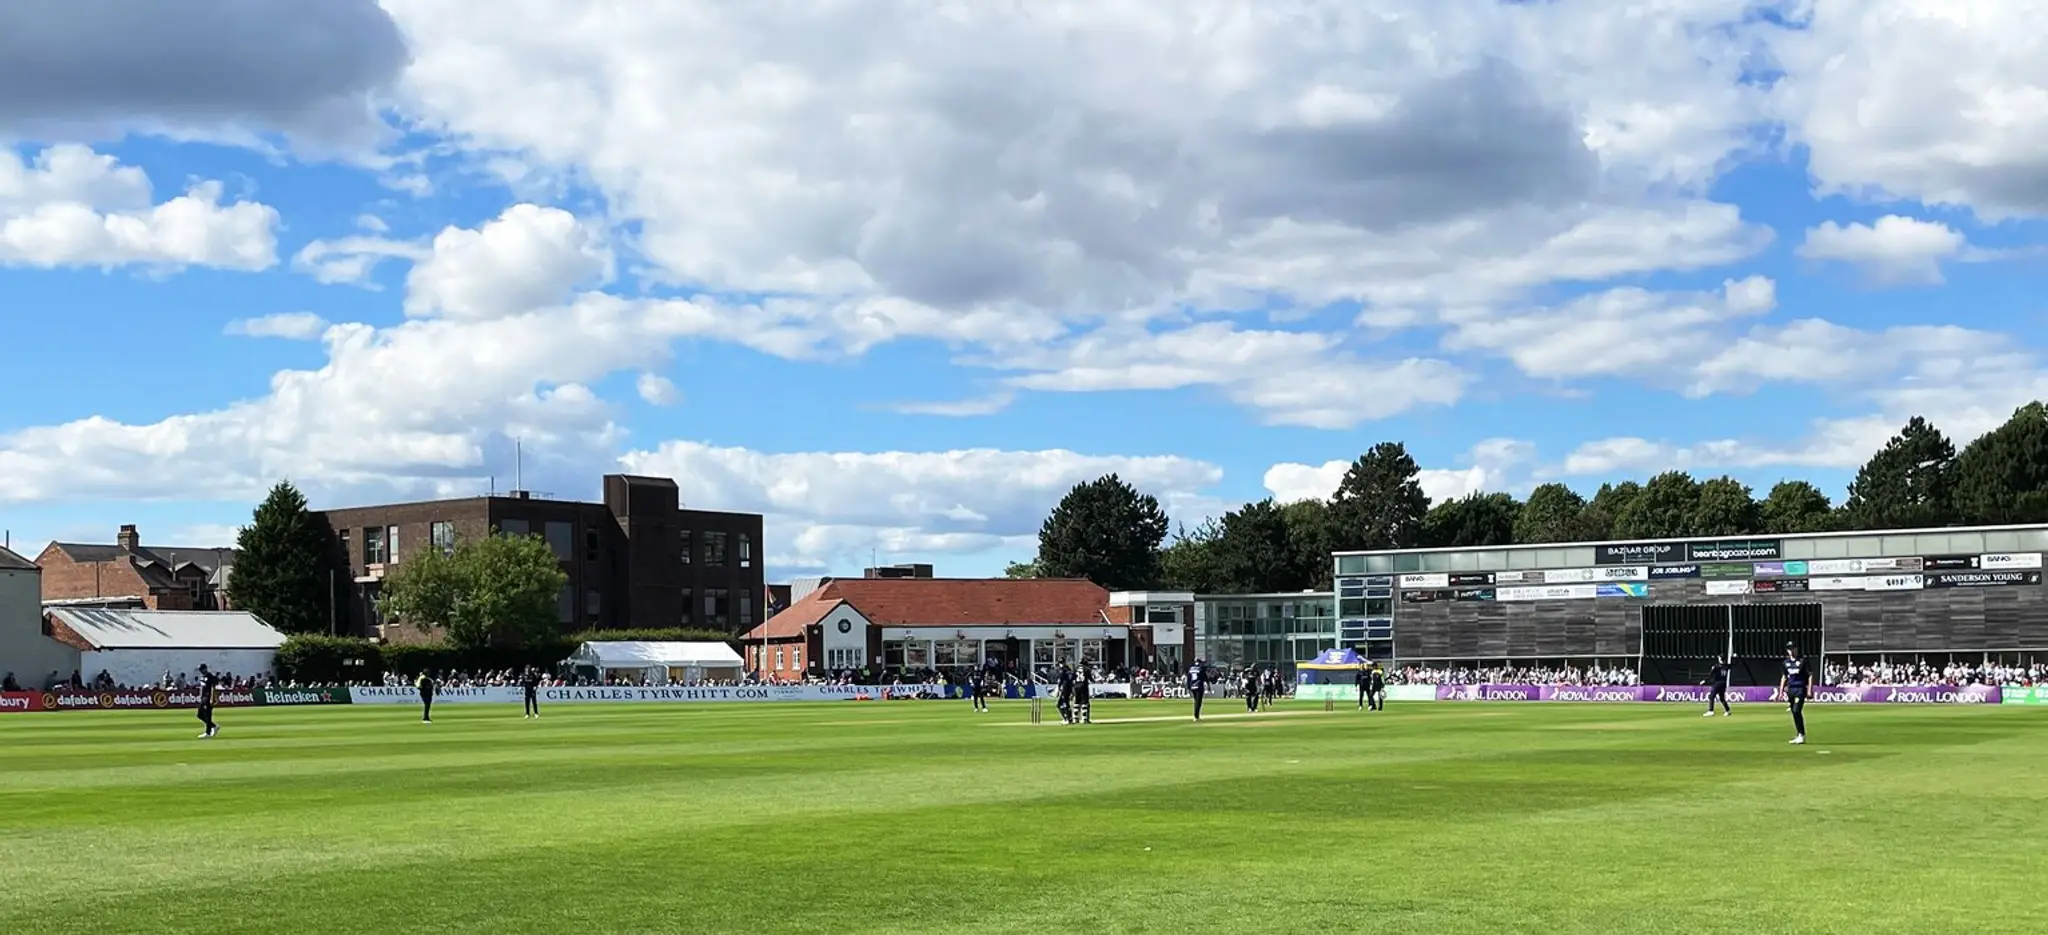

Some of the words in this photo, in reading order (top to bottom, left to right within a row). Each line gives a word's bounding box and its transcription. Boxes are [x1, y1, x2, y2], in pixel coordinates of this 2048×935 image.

[1607, 546, 1642, 555] BAZAAR
[1693, 547, 1777, 559] beanbagbazar.com
[1940, 573, 1991, 583] SANDERSON
[1992, 572, 2023, 581] YOUNG
[360, 688, 416, 697] CHARLES
[547, 689, 633, 700] CHARLES
[820, 686, 869, 694] CHARLES
[1456, 690, 1486, 700] ROYAL
[1487, 690, 1528, 700] LONDON
[57, 694, 98, 707] dafabet
[114, 693, 153, 706] dafabet
[169, 692, 202, 705] dafabe
[219, 691, 254, 704] dafabet
[264, 691, 320, 704] Heineken
[1560, 691, 1590, 701] ROYAL
[1666, 691, 1698, 701] ROYAL
[1700, 691, 1746, 702] LOON
[1814, 691, 1862, 702] LONDON
[1898, 692, 1934, 703] ROYAL
[1936, 691, 1986, 703] LONDON
